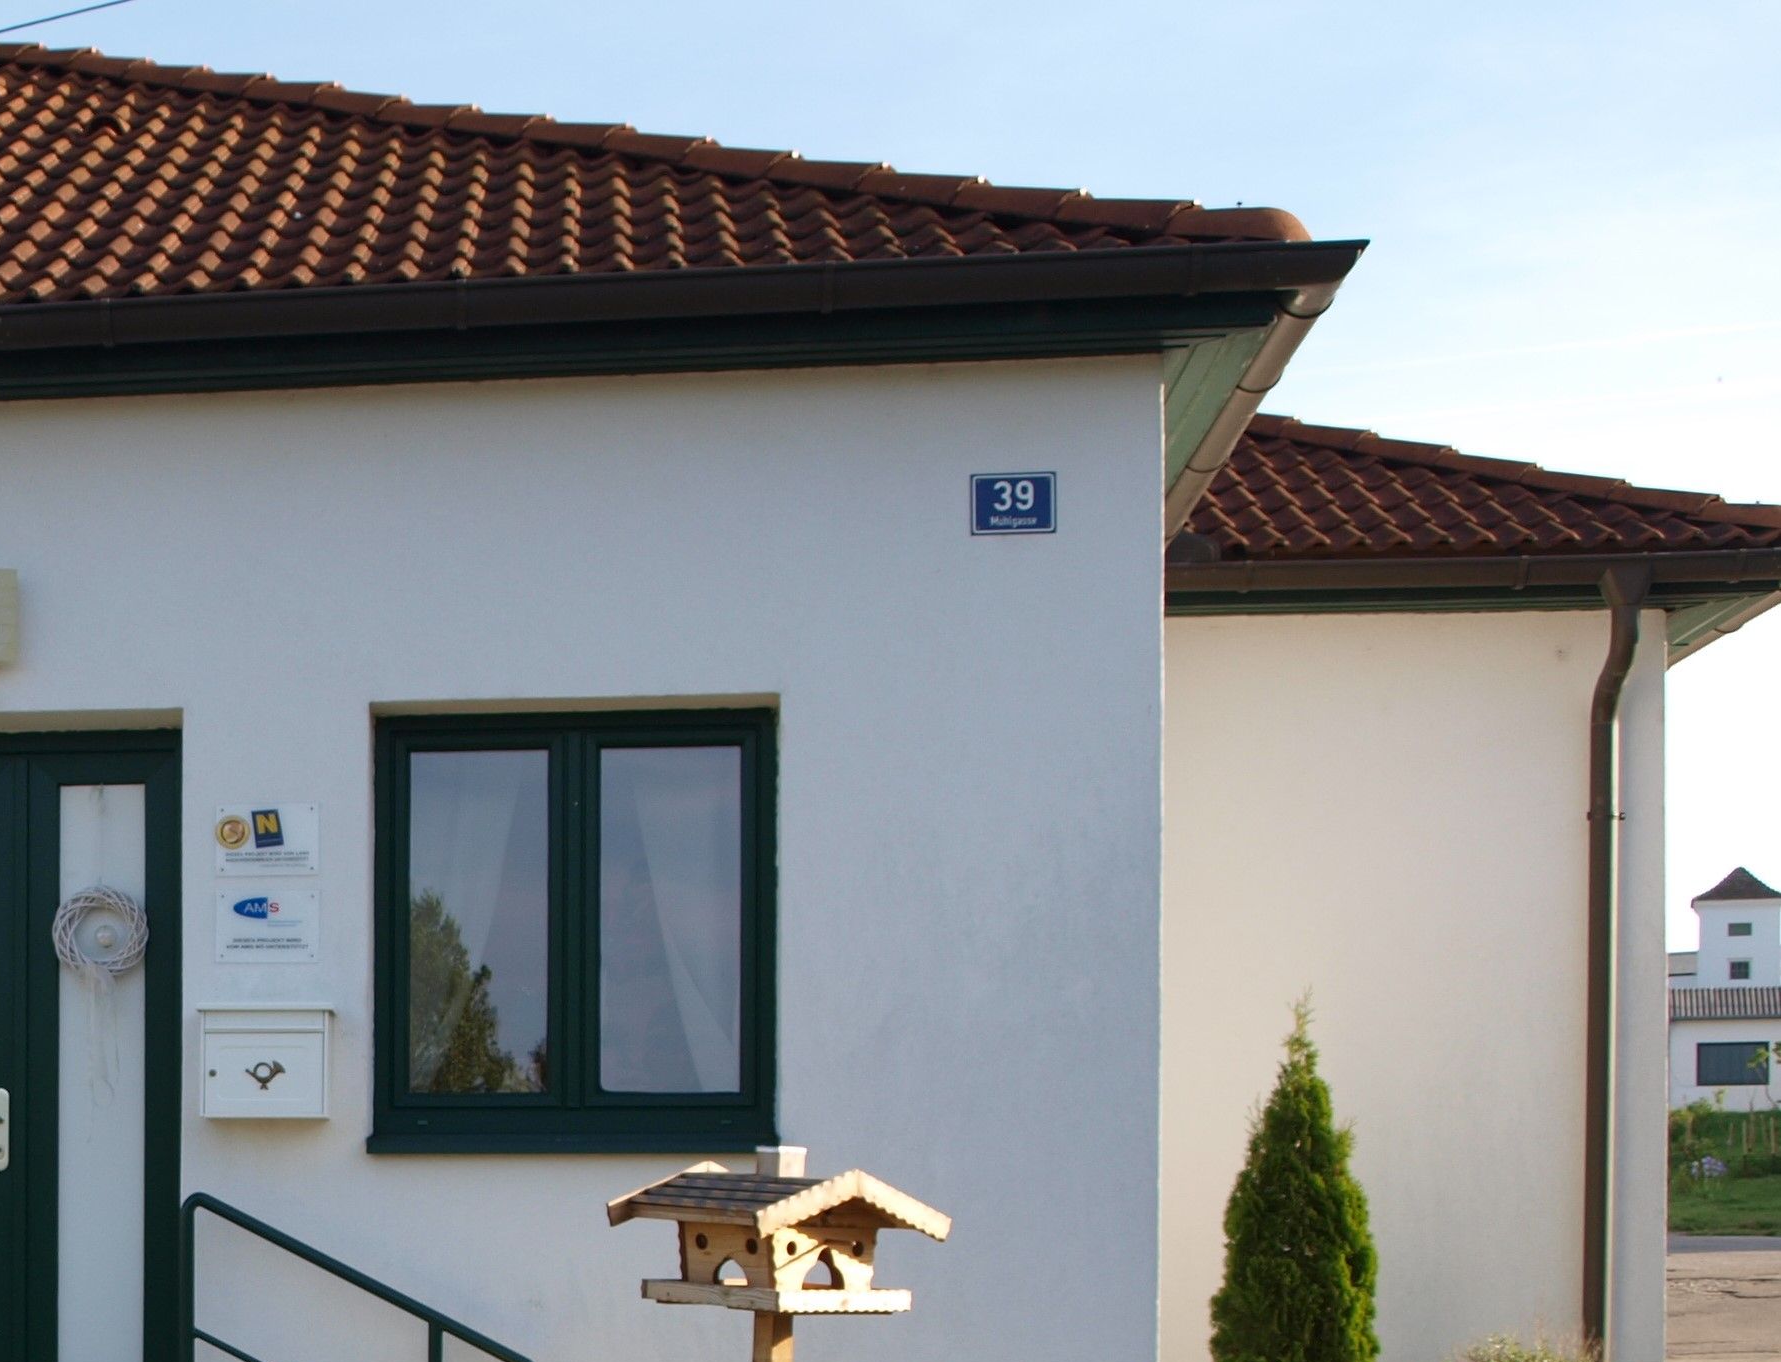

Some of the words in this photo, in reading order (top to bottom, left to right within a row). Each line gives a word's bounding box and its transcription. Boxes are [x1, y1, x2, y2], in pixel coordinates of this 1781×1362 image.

[993, 480, 1034, 512] 39
[255, 813, 279, 834] N
[244, 902, 279, 913] AMS
